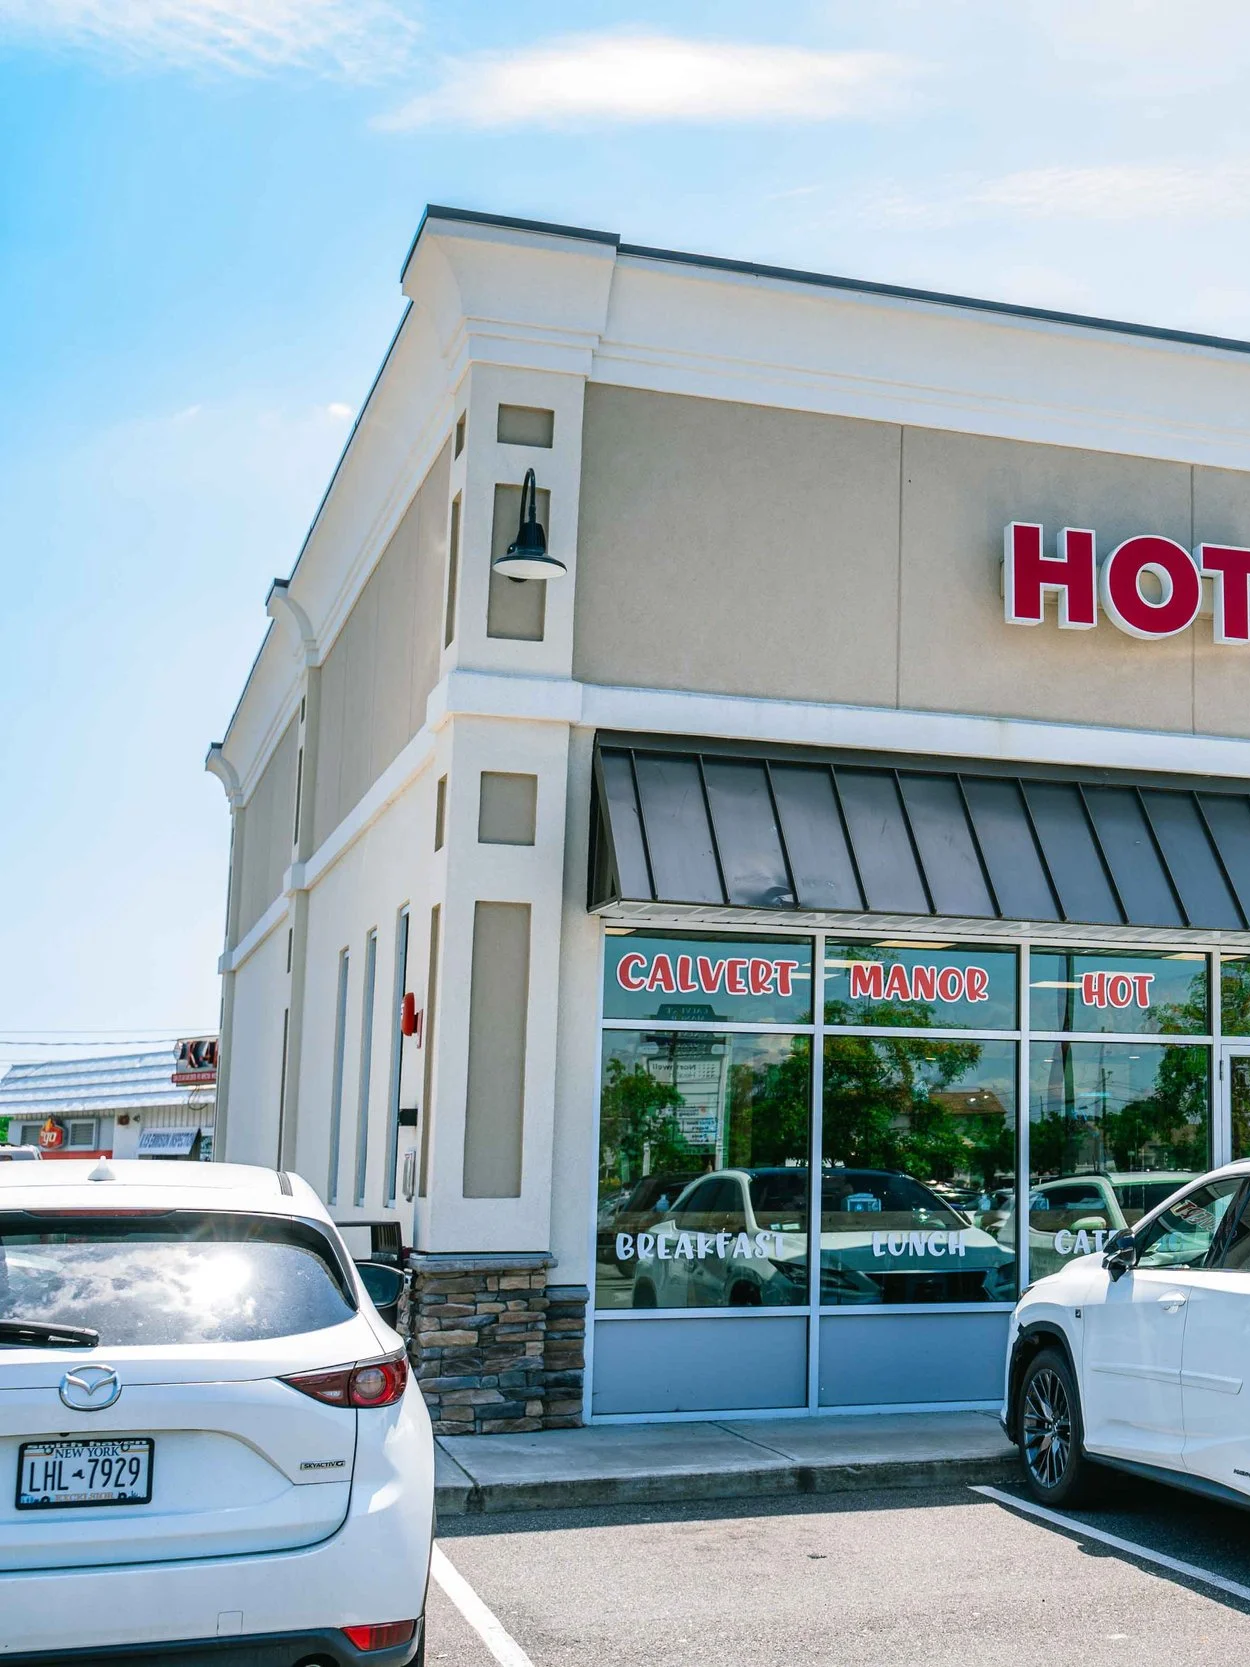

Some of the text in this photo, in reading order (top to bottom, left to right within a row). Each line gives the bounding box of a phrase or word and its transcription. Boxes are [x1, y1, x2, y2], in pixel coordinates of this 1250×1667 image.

[617, 952, 799, 997] CALVERT
[850, 963, 989, 1002] MANOR
[1081, 971, 1155, 1010] HOT
[614, 1231, 785, 1261] BREAKFAST
[871, 1230, 966, 1257] LUNCH
[55, 1446, 120, 1458] NEW YORK
[29, 1456, 141, 1492] LHL 7929
